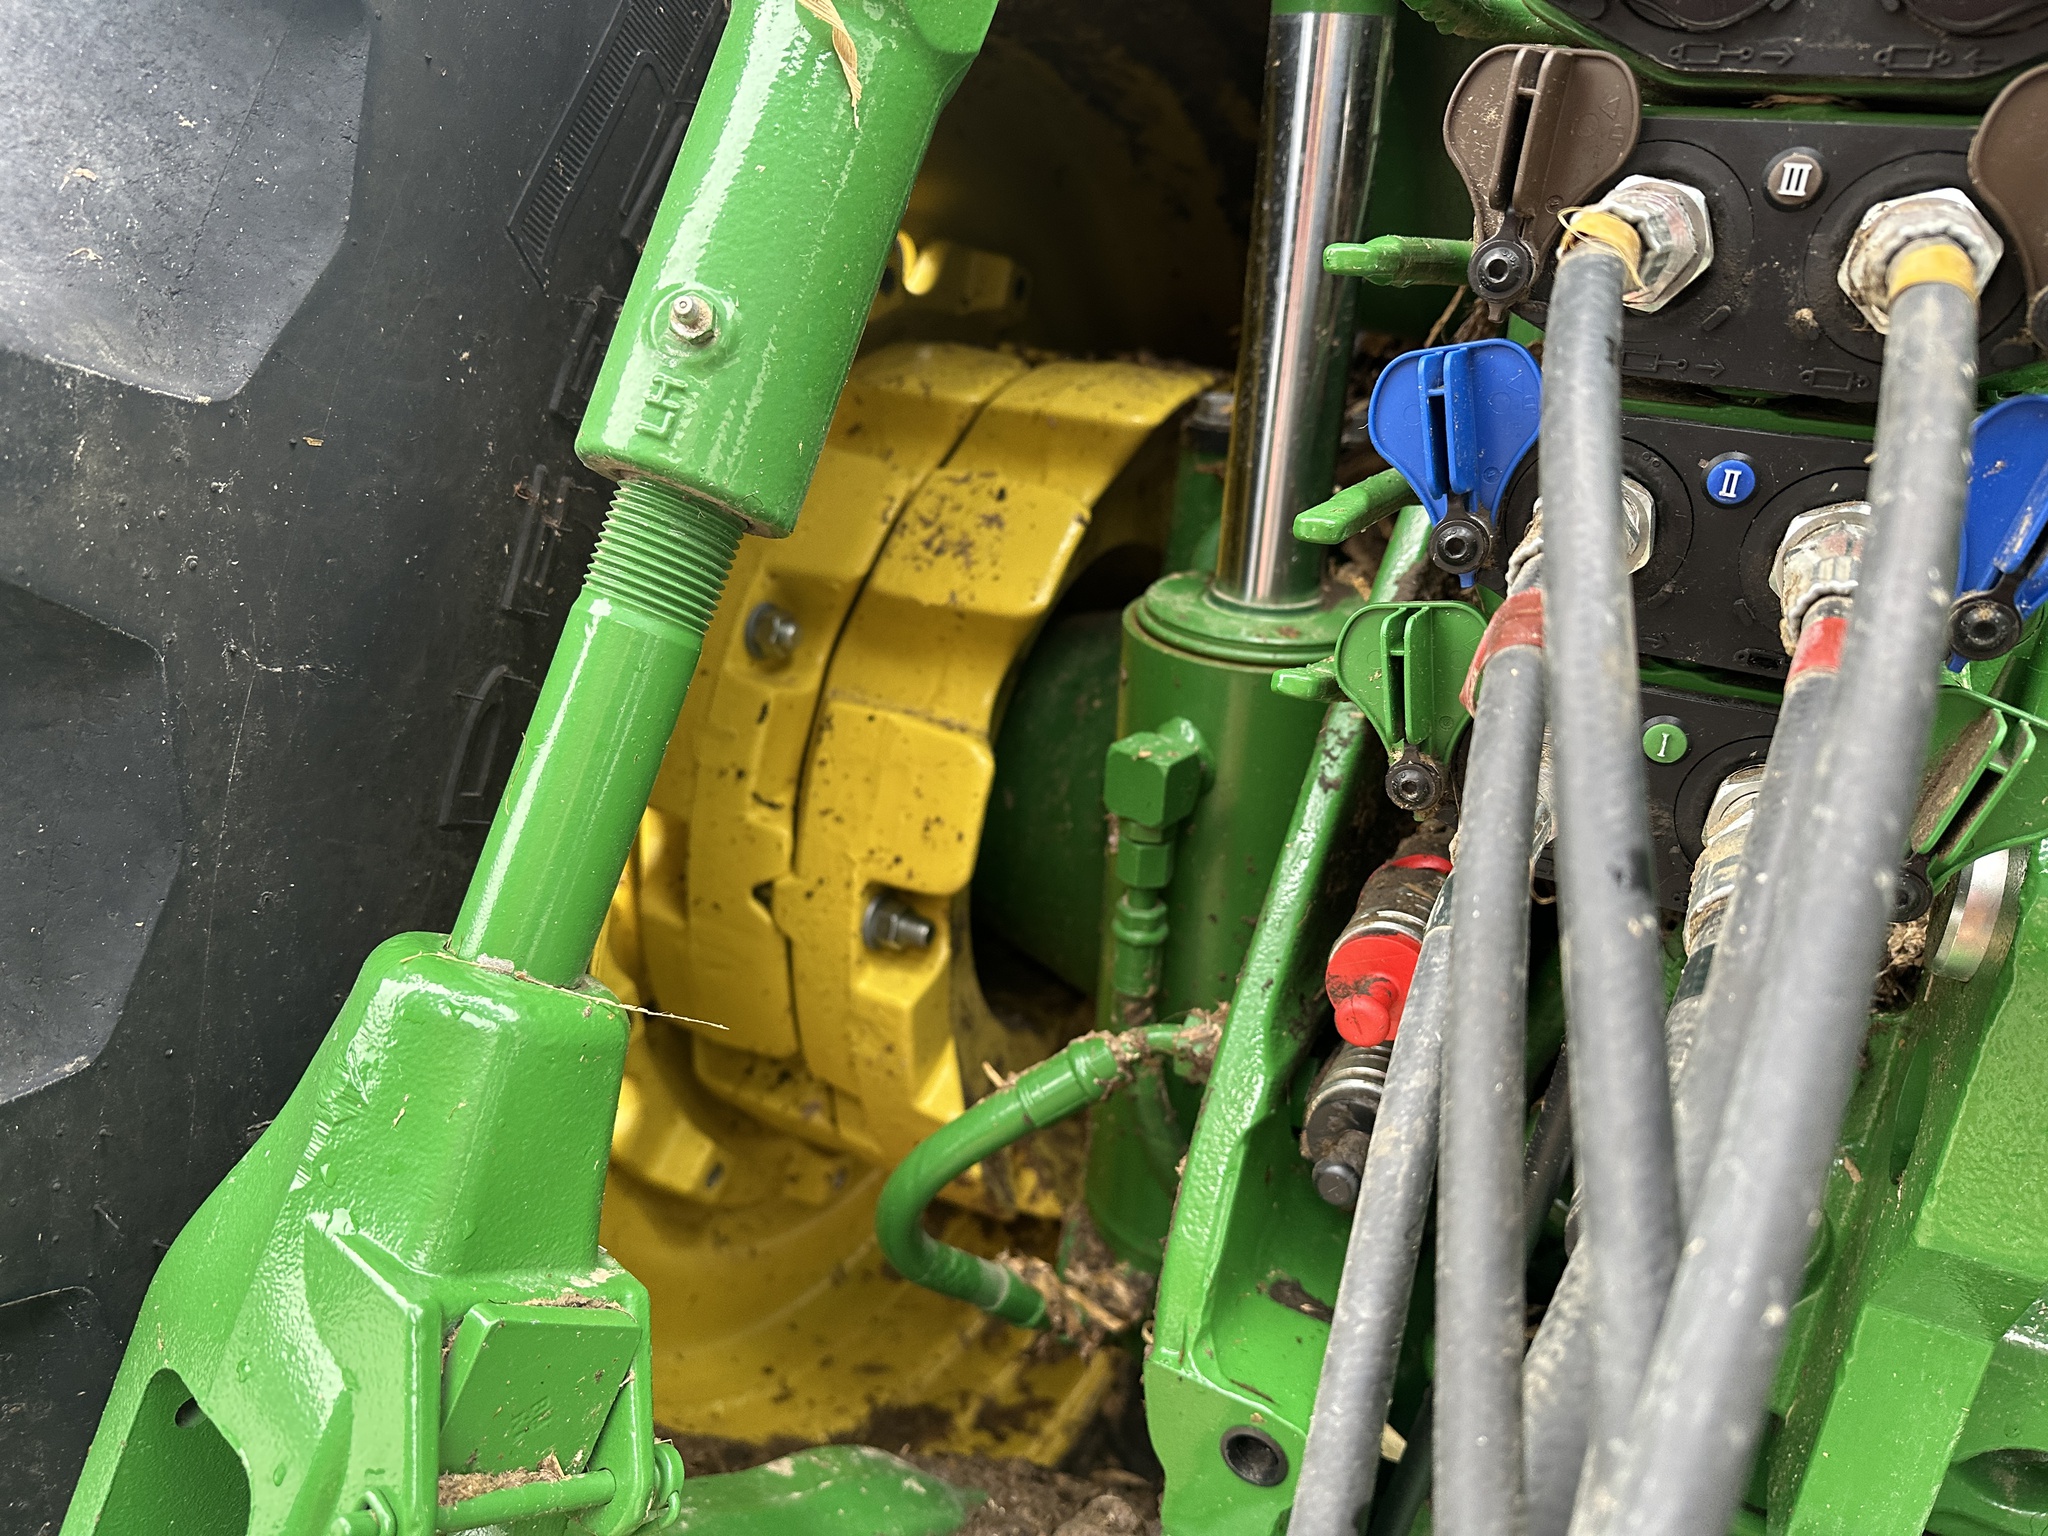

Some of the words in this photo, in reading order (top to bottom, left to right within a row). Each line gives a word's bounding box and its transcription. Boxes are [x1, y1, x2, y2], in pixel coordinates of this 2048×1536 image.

[1778, 162, 1813, 197] III
[634, 372, 689, 438] LH
[1719, 468, 1743, 498] II
[1656, 732, 1670, 757] I
